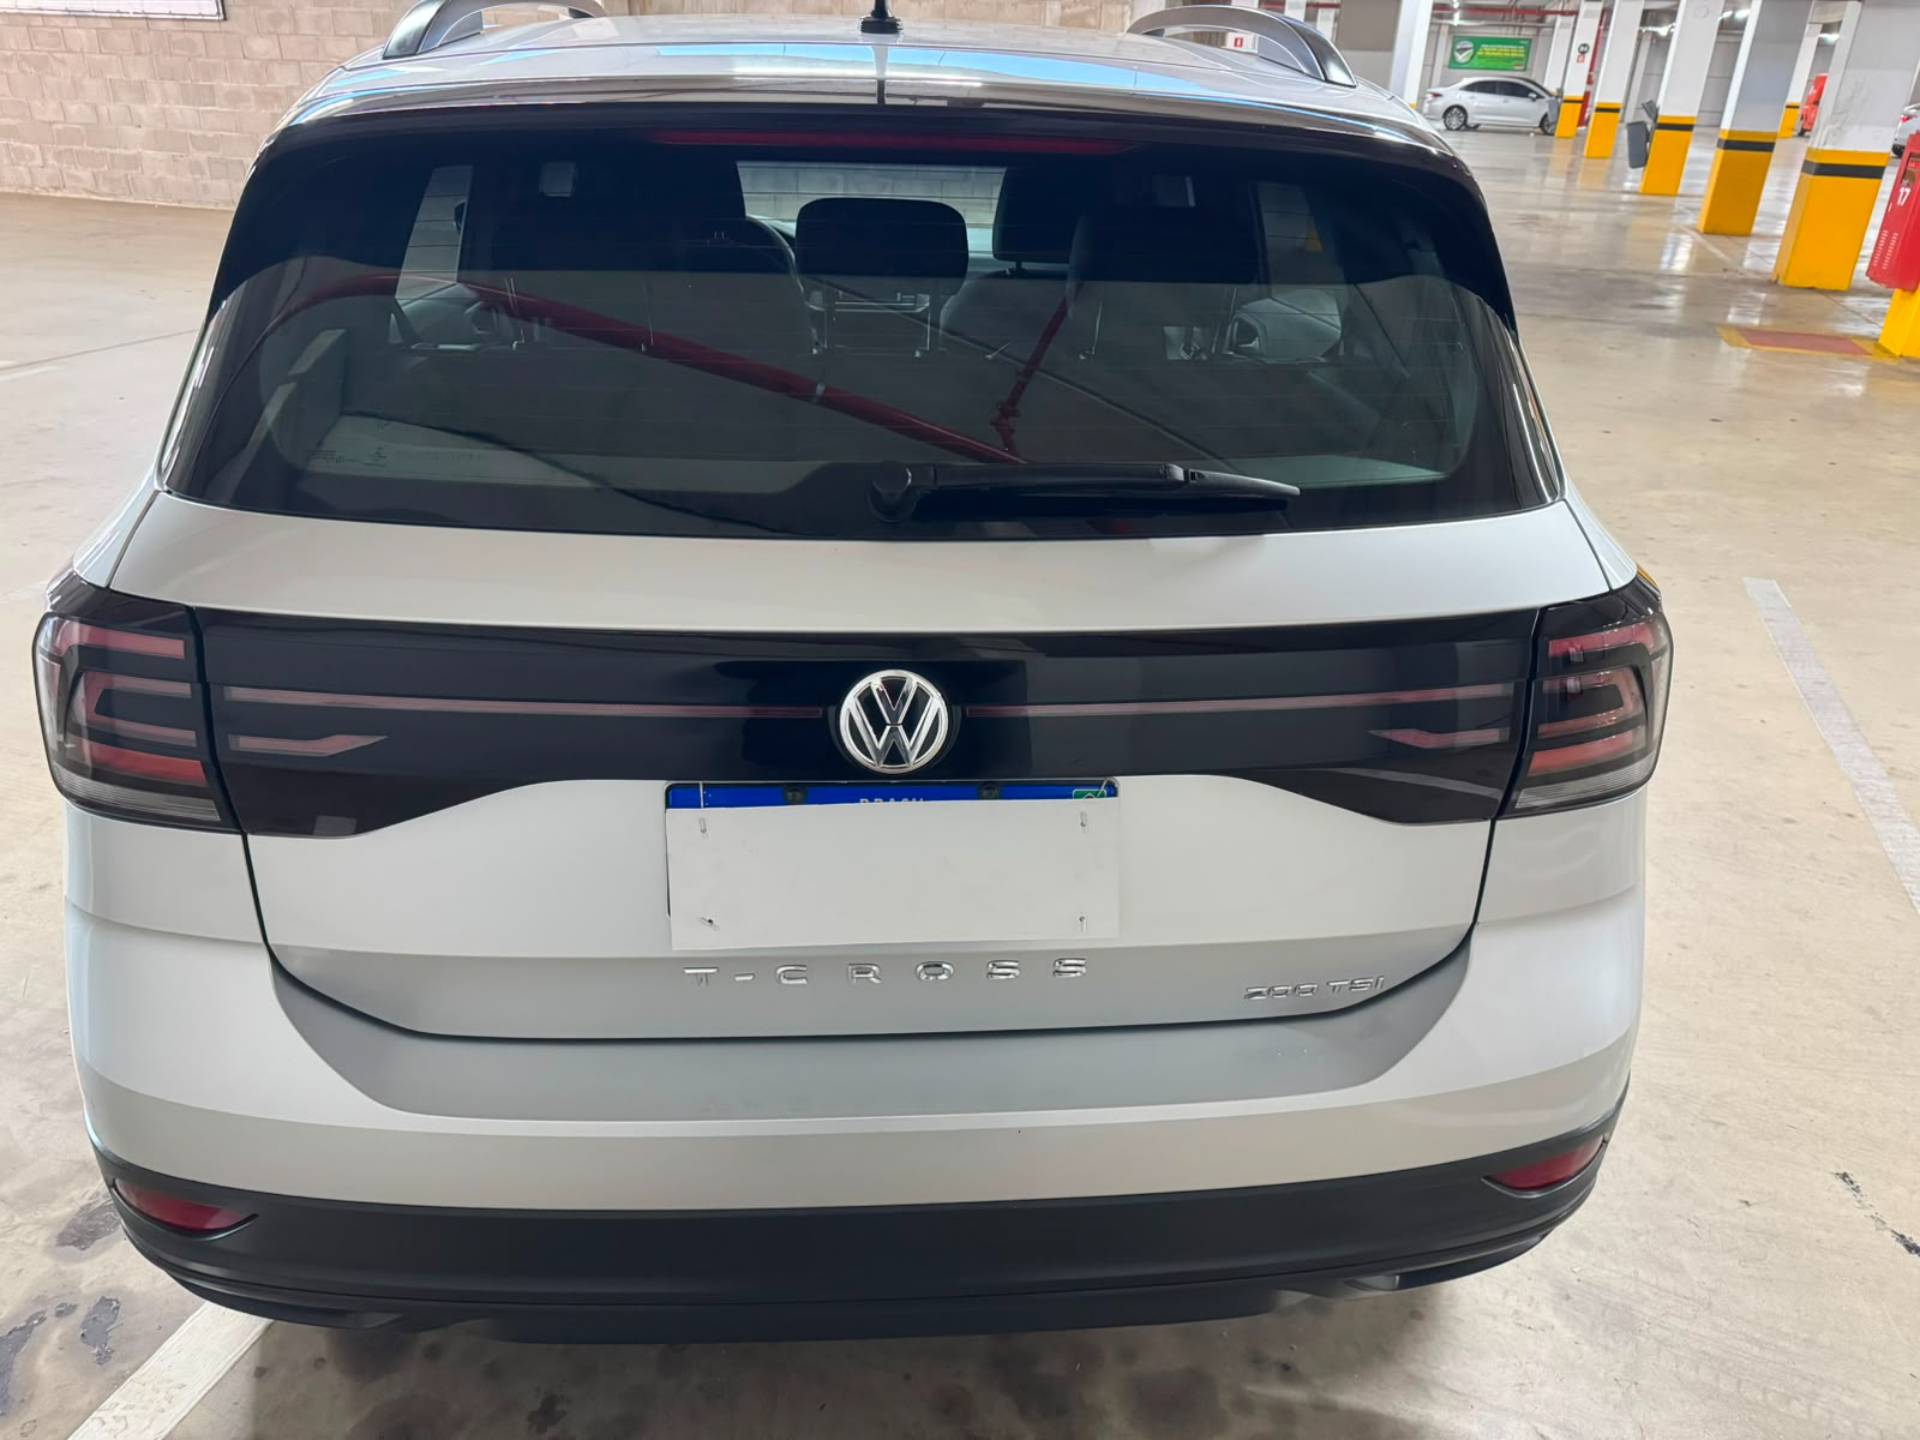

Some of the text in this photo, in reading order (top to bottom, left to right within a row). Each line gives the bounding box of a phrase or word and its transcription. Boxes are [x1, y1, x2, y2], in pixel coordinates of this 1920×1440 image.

[1897, 187, 1911, 206] 17
[683, 957, 1087, 986] T-CROSS
[1243, 974, 1385, 1001] 200 TSI
